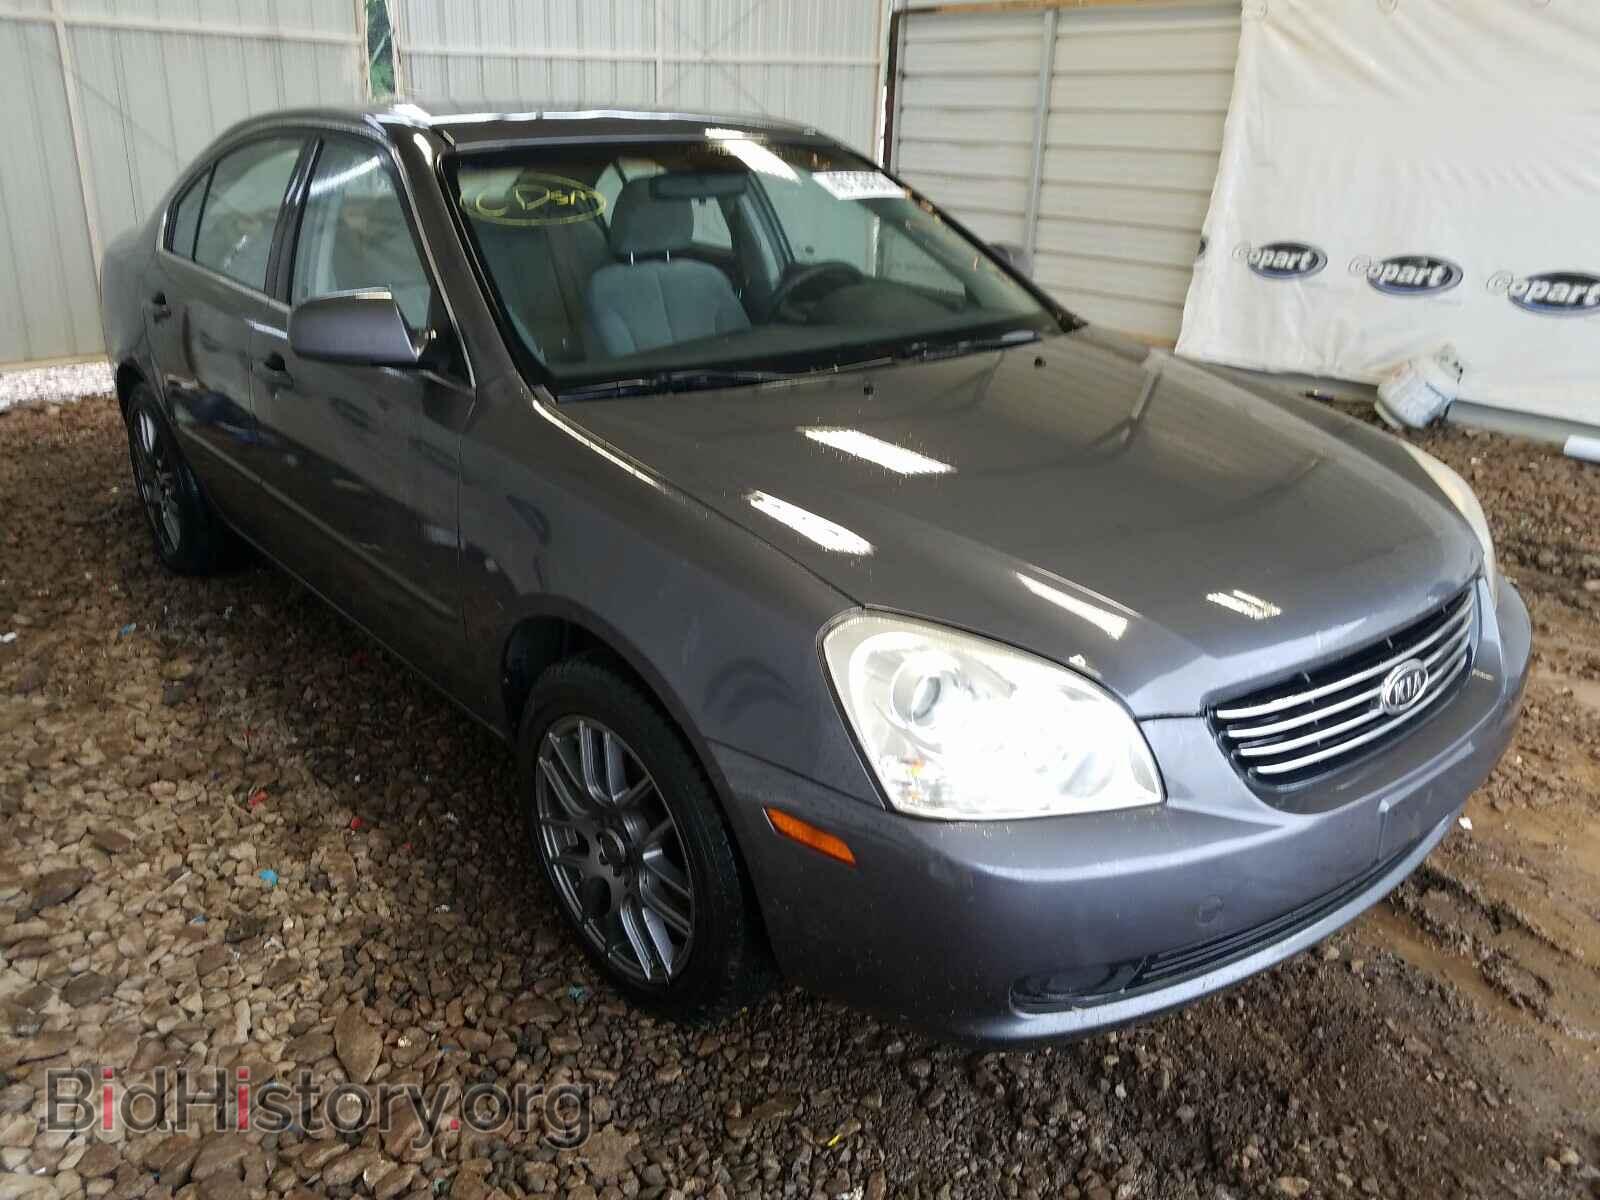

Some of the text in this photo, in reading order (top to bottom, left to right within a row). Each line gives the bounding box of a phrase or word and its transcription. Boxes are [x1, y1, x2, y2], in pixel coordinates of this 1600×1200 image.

[1231, 239, 1313, 271] Copart
[1347, 253, 1446, 287] Copart
[1393, 670, 1423, 705] KIA
